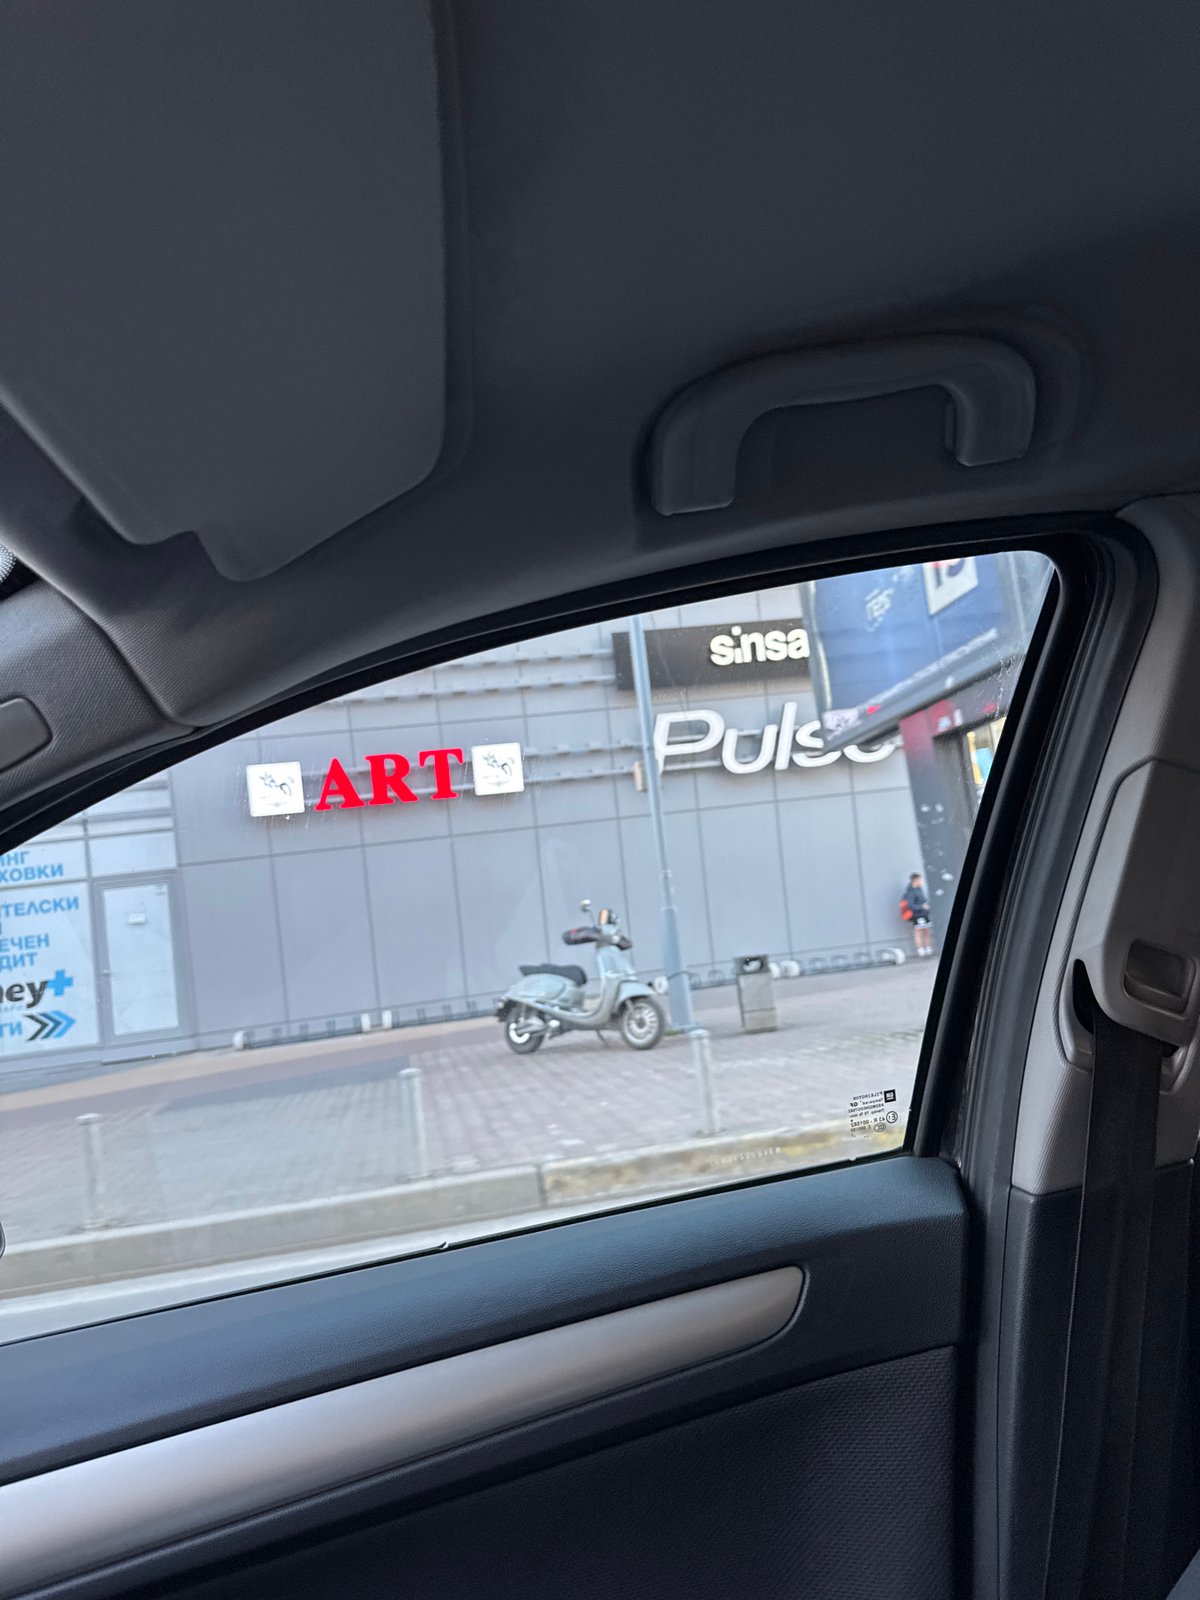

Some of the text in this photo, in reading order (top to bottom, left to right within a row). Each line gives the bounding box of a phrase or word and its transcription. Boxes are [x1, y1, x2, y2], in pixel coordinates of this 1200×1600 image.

[709, 625, 811, 667] sinsa
[313, 747, 465, 812] ART
[0, 896, 80, 918] ТЕЛСКИ
